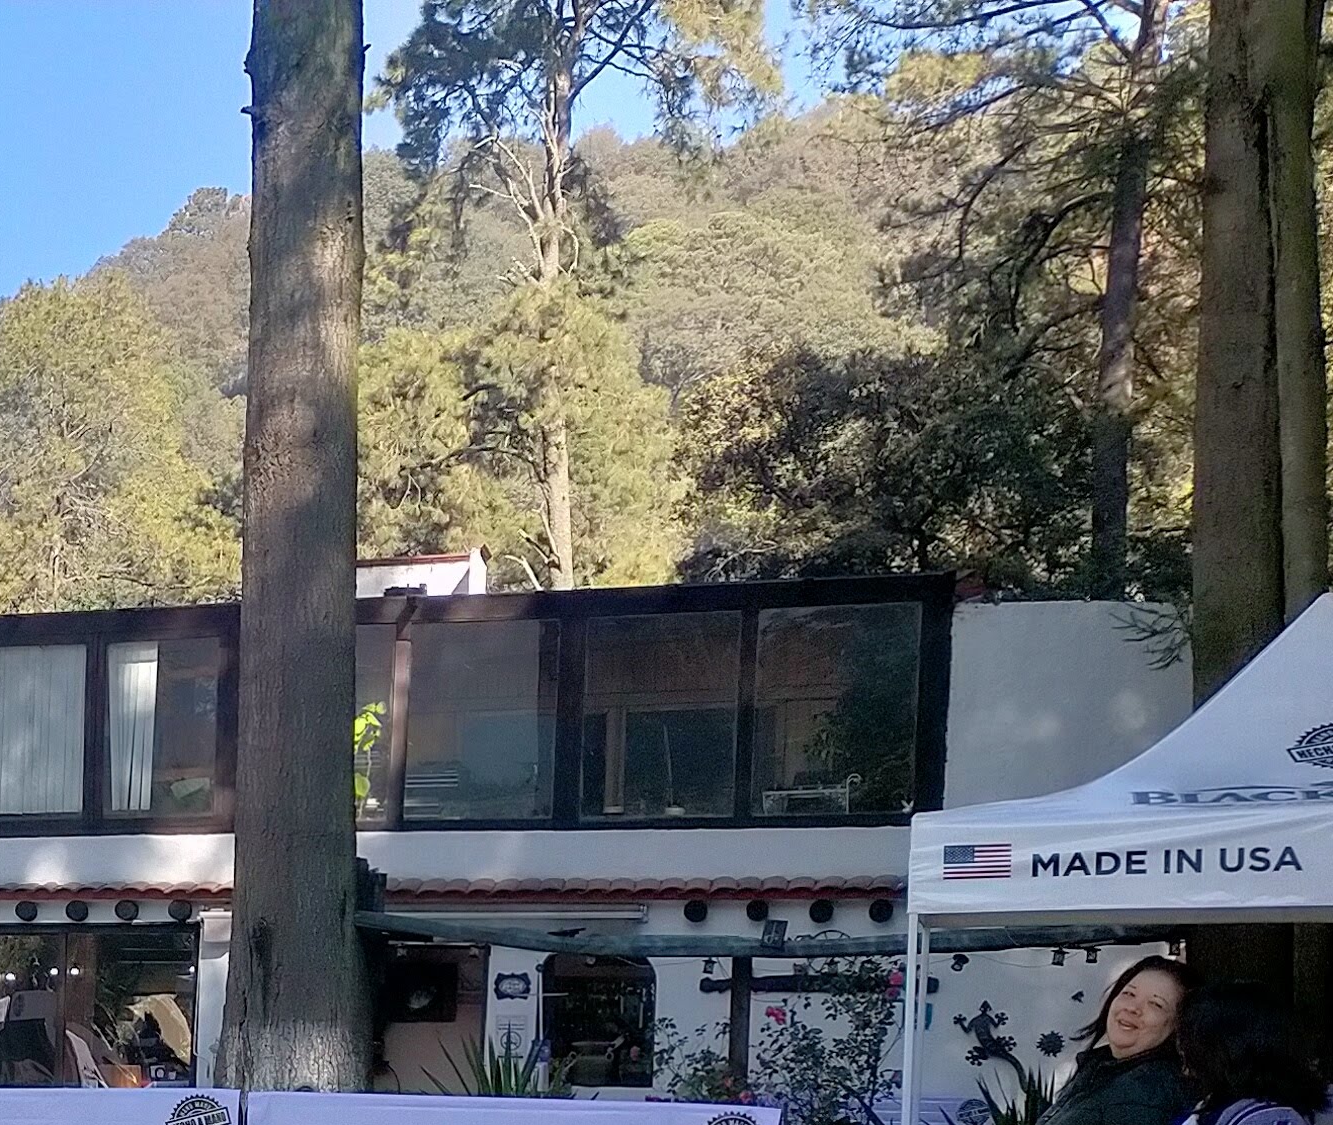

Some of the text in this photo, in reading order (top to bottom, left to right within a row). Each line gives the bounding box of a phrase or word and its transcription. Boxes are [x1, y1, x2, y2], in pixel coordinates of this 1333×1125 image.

[1295, 744, 1333, 759] HECH
[1132, 789, 1333, 806] BLACK
[1031, 846, 1303, 878] MADE IN USA
